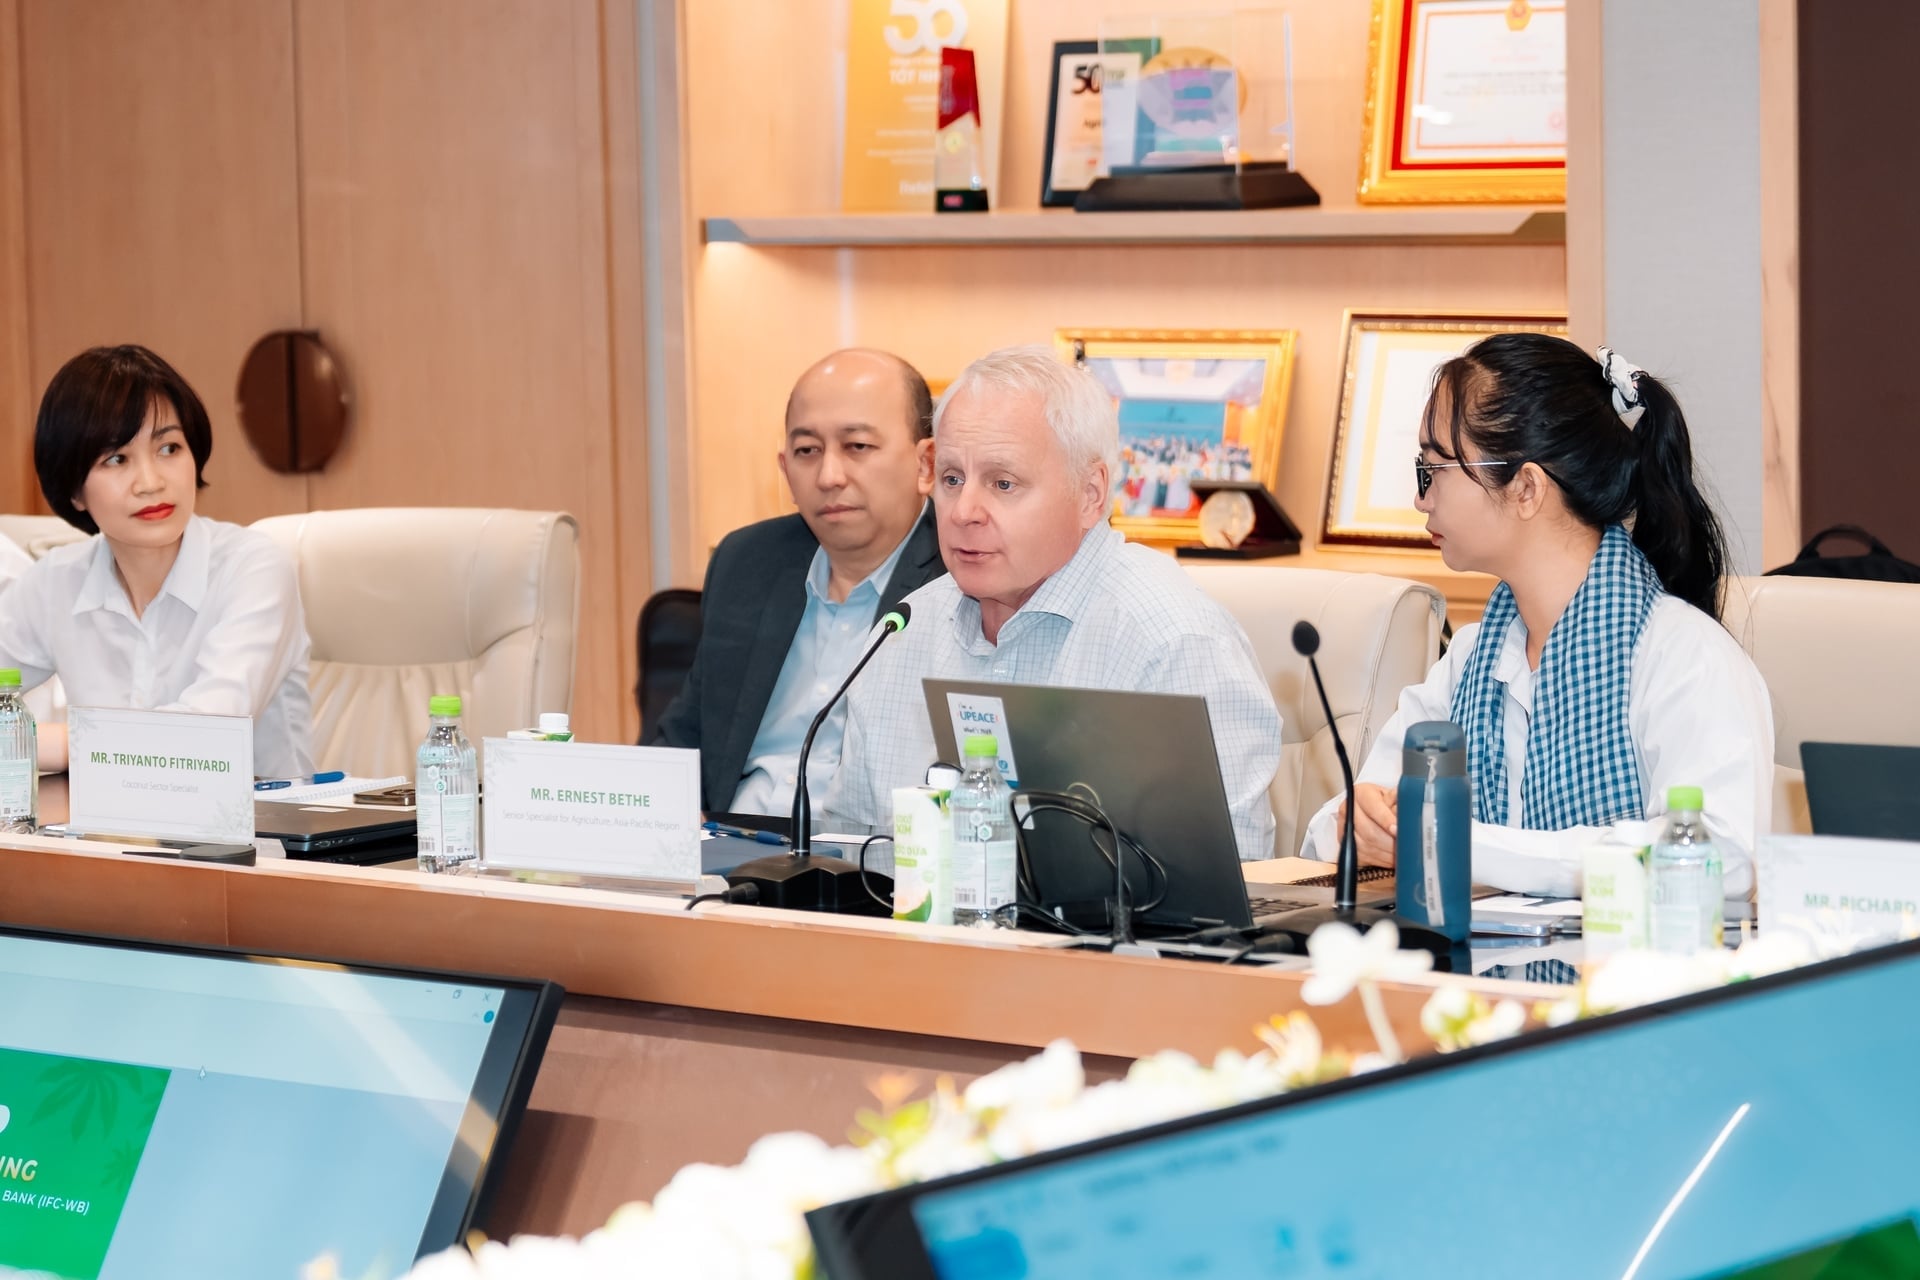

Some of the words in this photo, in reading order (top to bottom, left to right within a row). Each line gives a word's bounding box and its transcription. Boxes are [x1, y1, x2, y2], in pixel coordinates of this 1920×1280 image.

[884, 0, 968, 55] 50
[1071, 64, 1103, 94] 50
[91, 751, 111, 764] MR.
[113, 753, 167, 768] TRIYANTO
[169, 757, 230, 773] FITRIYARDI
[531, 787, 554, 801] MR.
[557, 789, 605, 804] ERNEST
[609, 792, 650, 808] BETHE
[1840, 896, 1917, 914] RICHARD
[2, 1190, 37, 1206] BANK
[37, 1194, 90, 1216] (IFC-WB)
